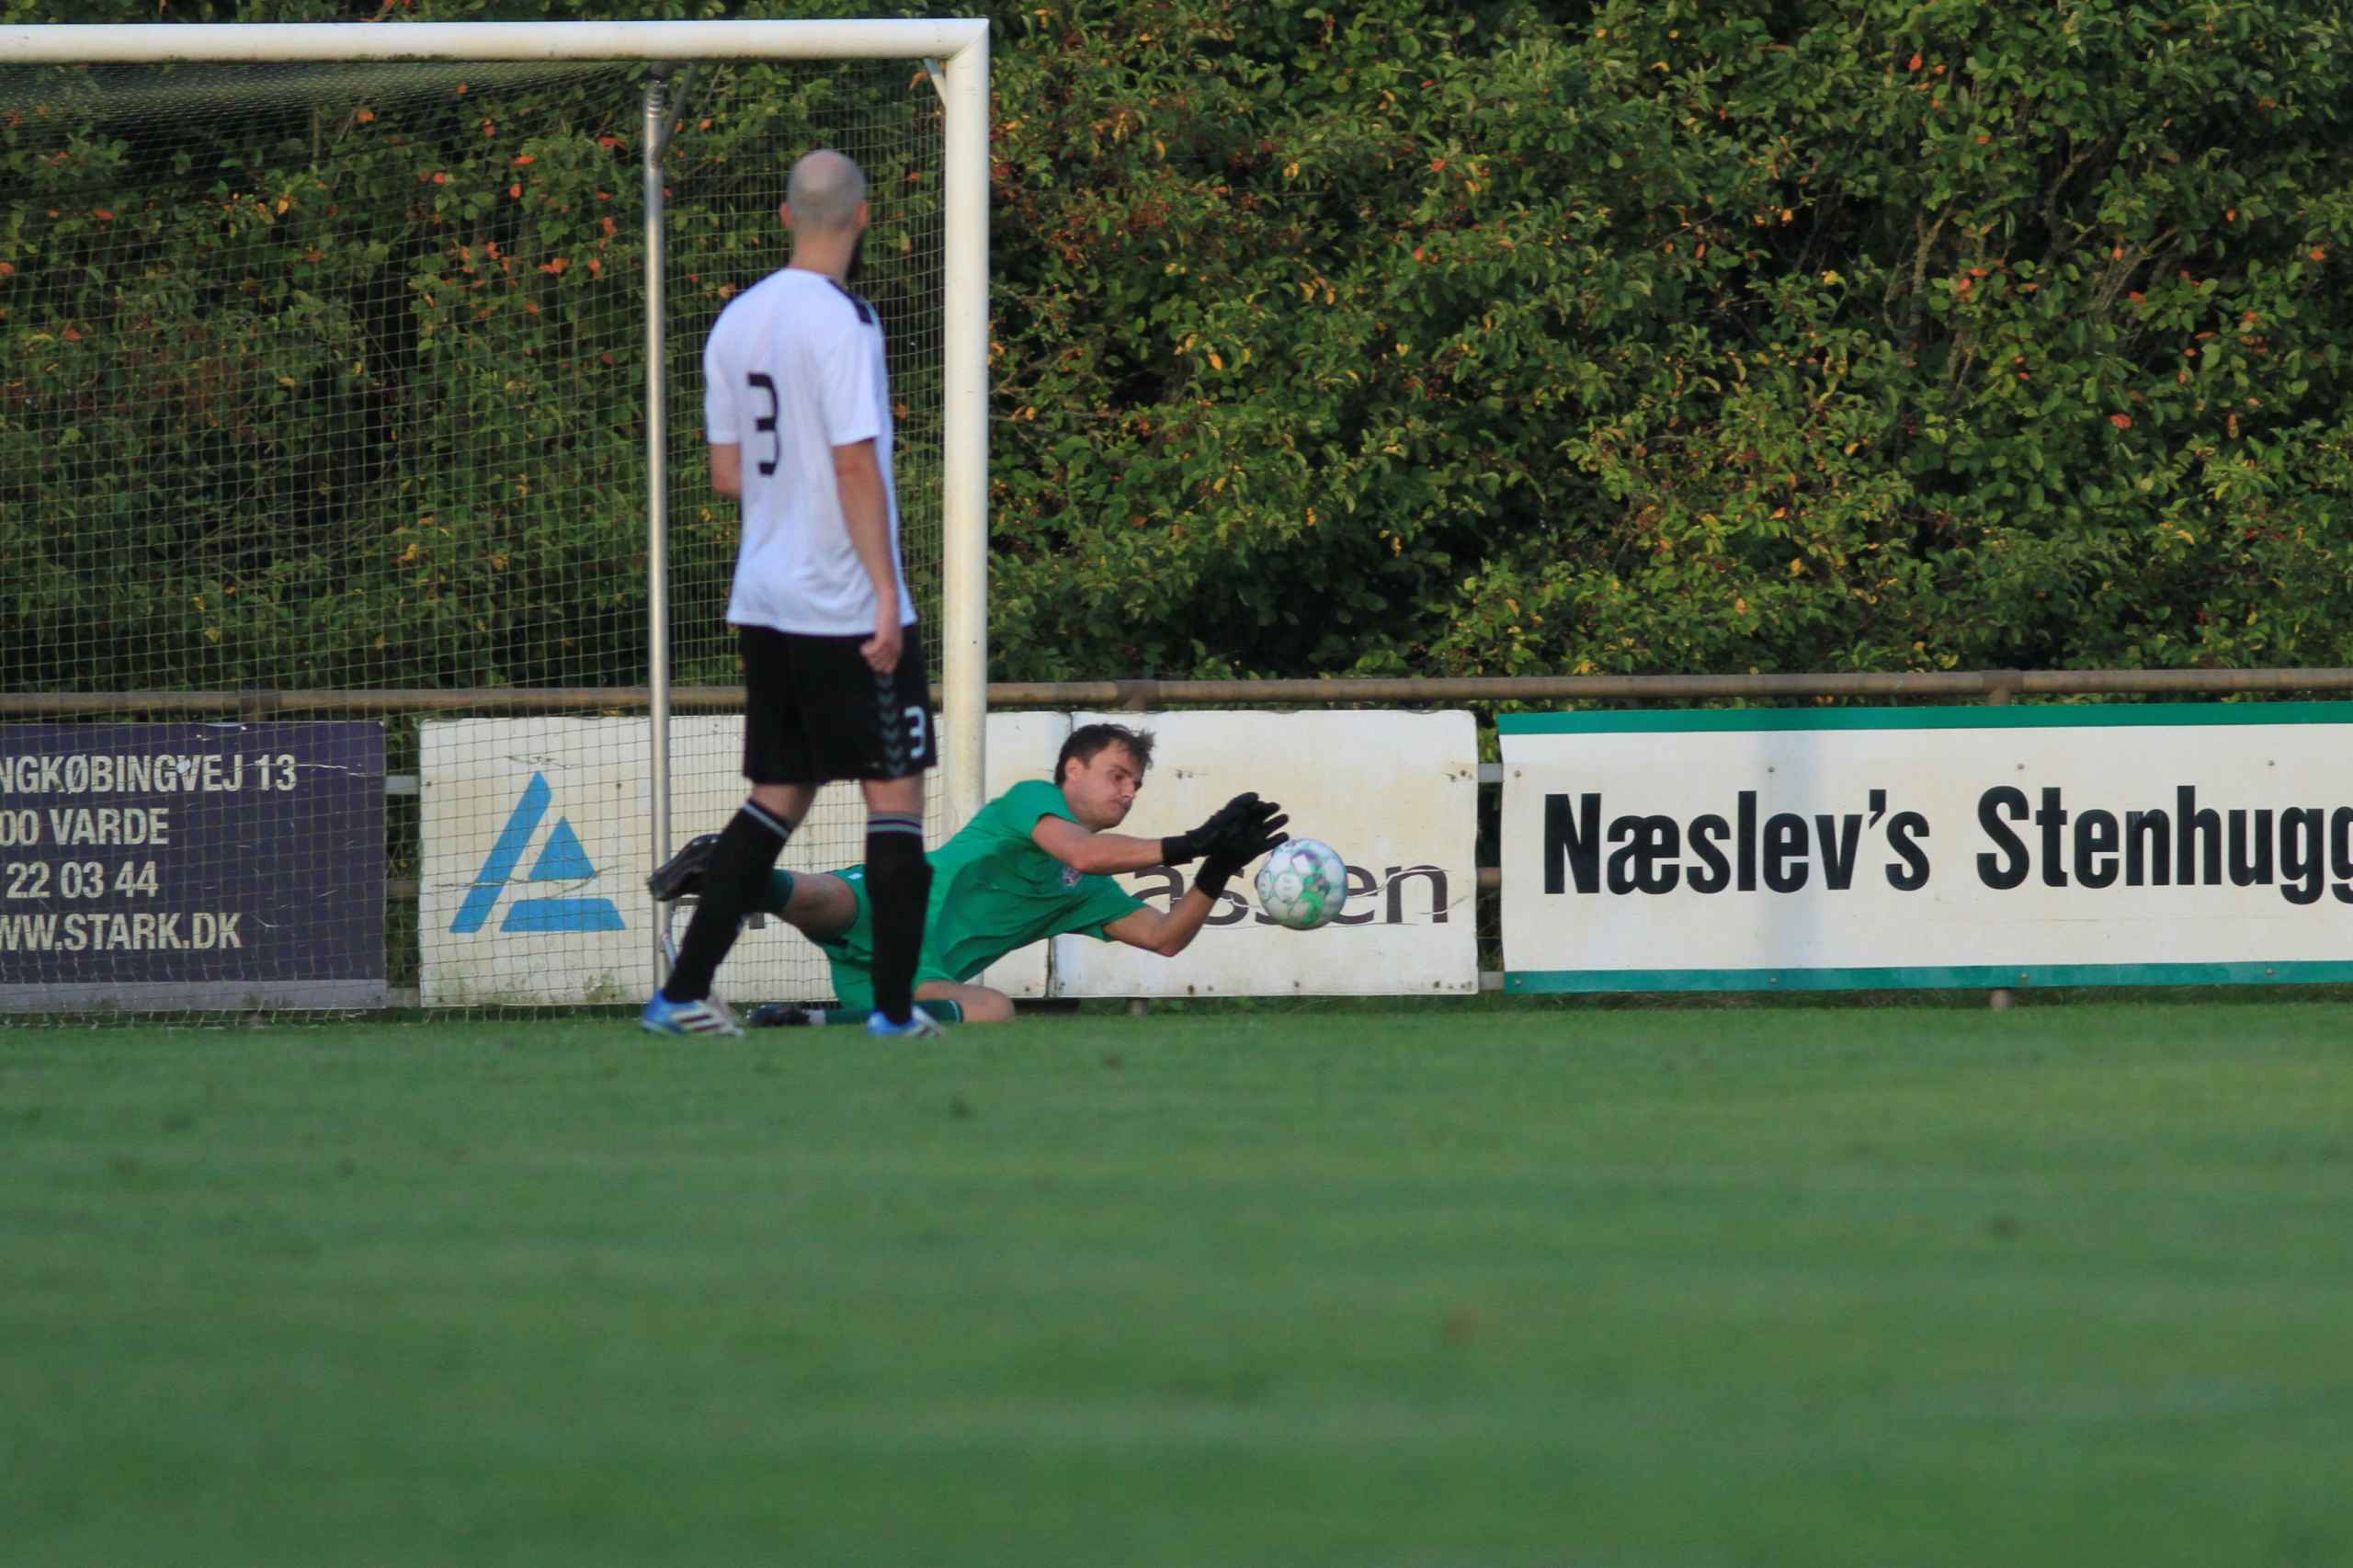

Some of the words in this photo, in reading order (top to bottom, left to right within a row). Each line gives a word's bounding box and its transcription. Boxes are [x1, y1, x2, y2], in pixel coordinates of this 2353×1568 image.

[747, 372, 781, 476] 3
[904, 706, 926, 759] 3
[258, 754, 298, 792] 13
[0, 809, 40, 846] 00
[49, 808, 170, 846] VARDE
[6, 862, 51, 899] 22
[61, 861, 104, 899] 03
[114, 861, 160, 898] 44
